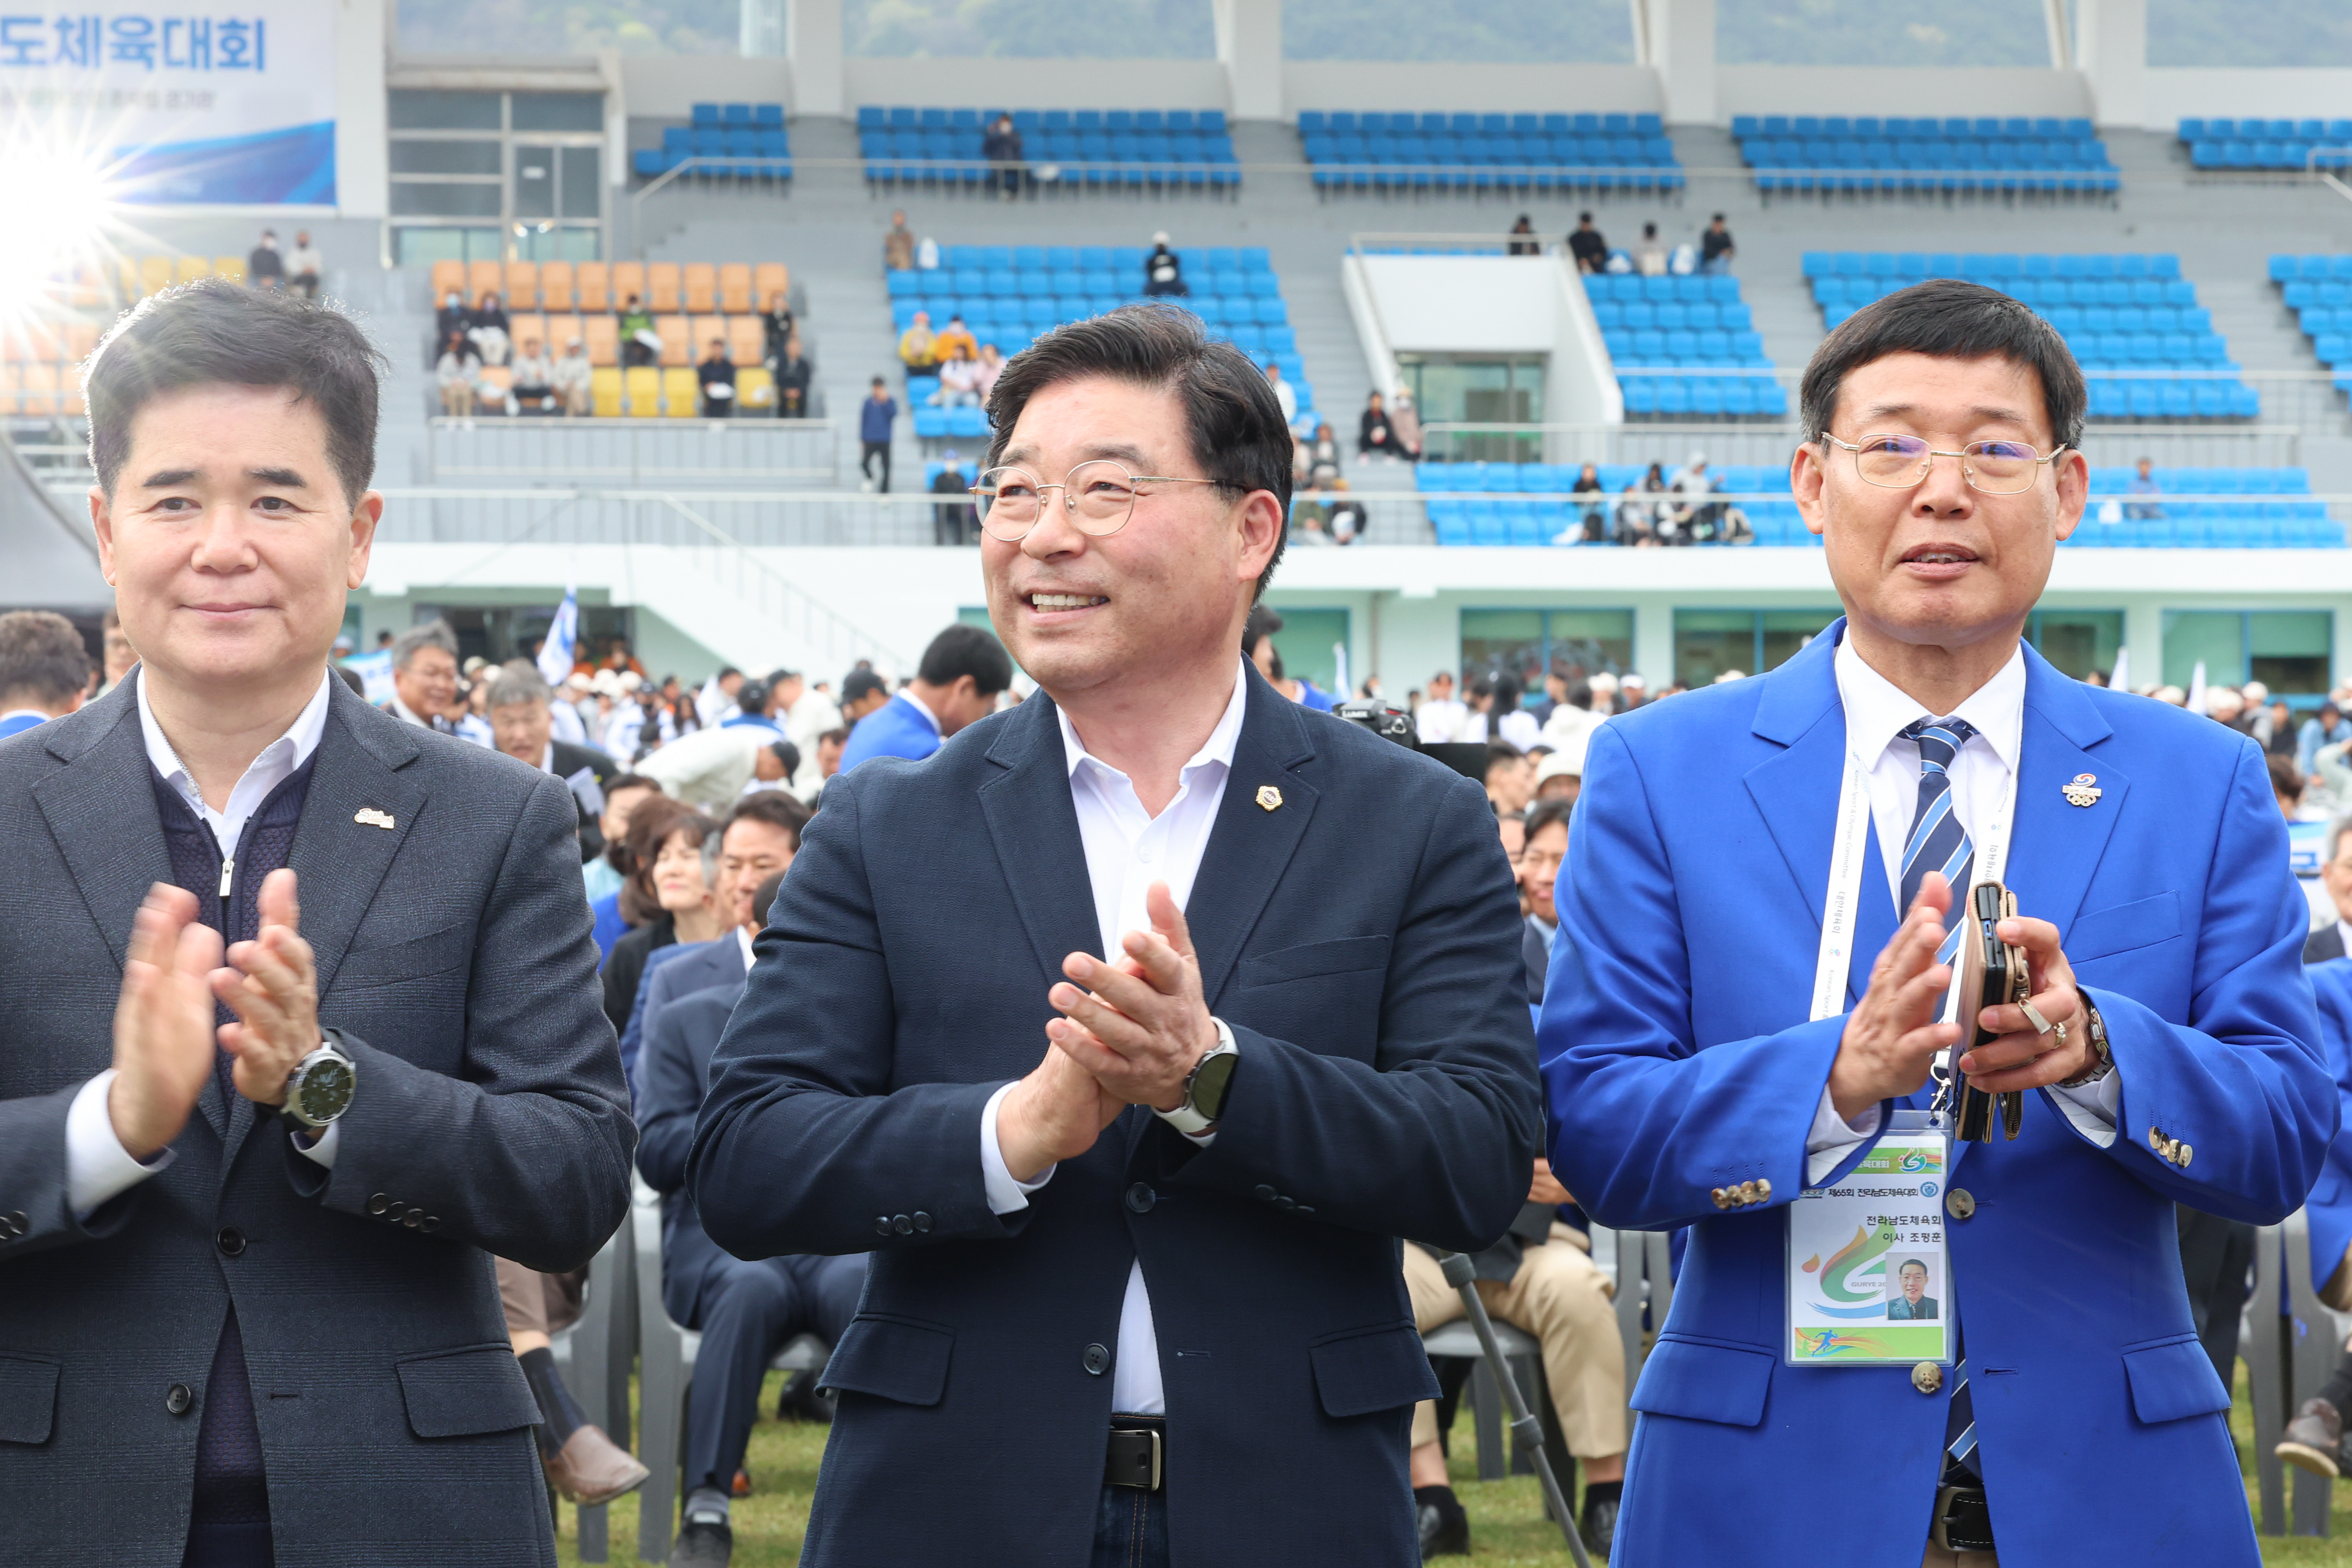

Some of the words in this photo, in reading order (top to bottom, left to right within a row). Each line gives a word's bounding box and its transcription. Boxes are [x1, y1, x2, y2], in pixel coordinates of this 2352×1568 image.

[0, 15, 266, 71] 도체육대회
[1847, 815, 1856, 841] Olympic
[1842, 843, 1852, 879] Committee
[1832, 891, 1845, 933] 대한체육회
[1826, 970, 1835, 992] Korean
[1824, 995, 1832, 1013] Sport
[1828, 1188, 1854, 1197] 제65회
[1857, 1188, 1918, 1197] 전라남도체육대회
[1866, 1215, 1941, 1226] 전라남도체육회
[1883, 1233, 1904, 1243] 이사
[1909, 1232, 1942, 1243] 조평훈
